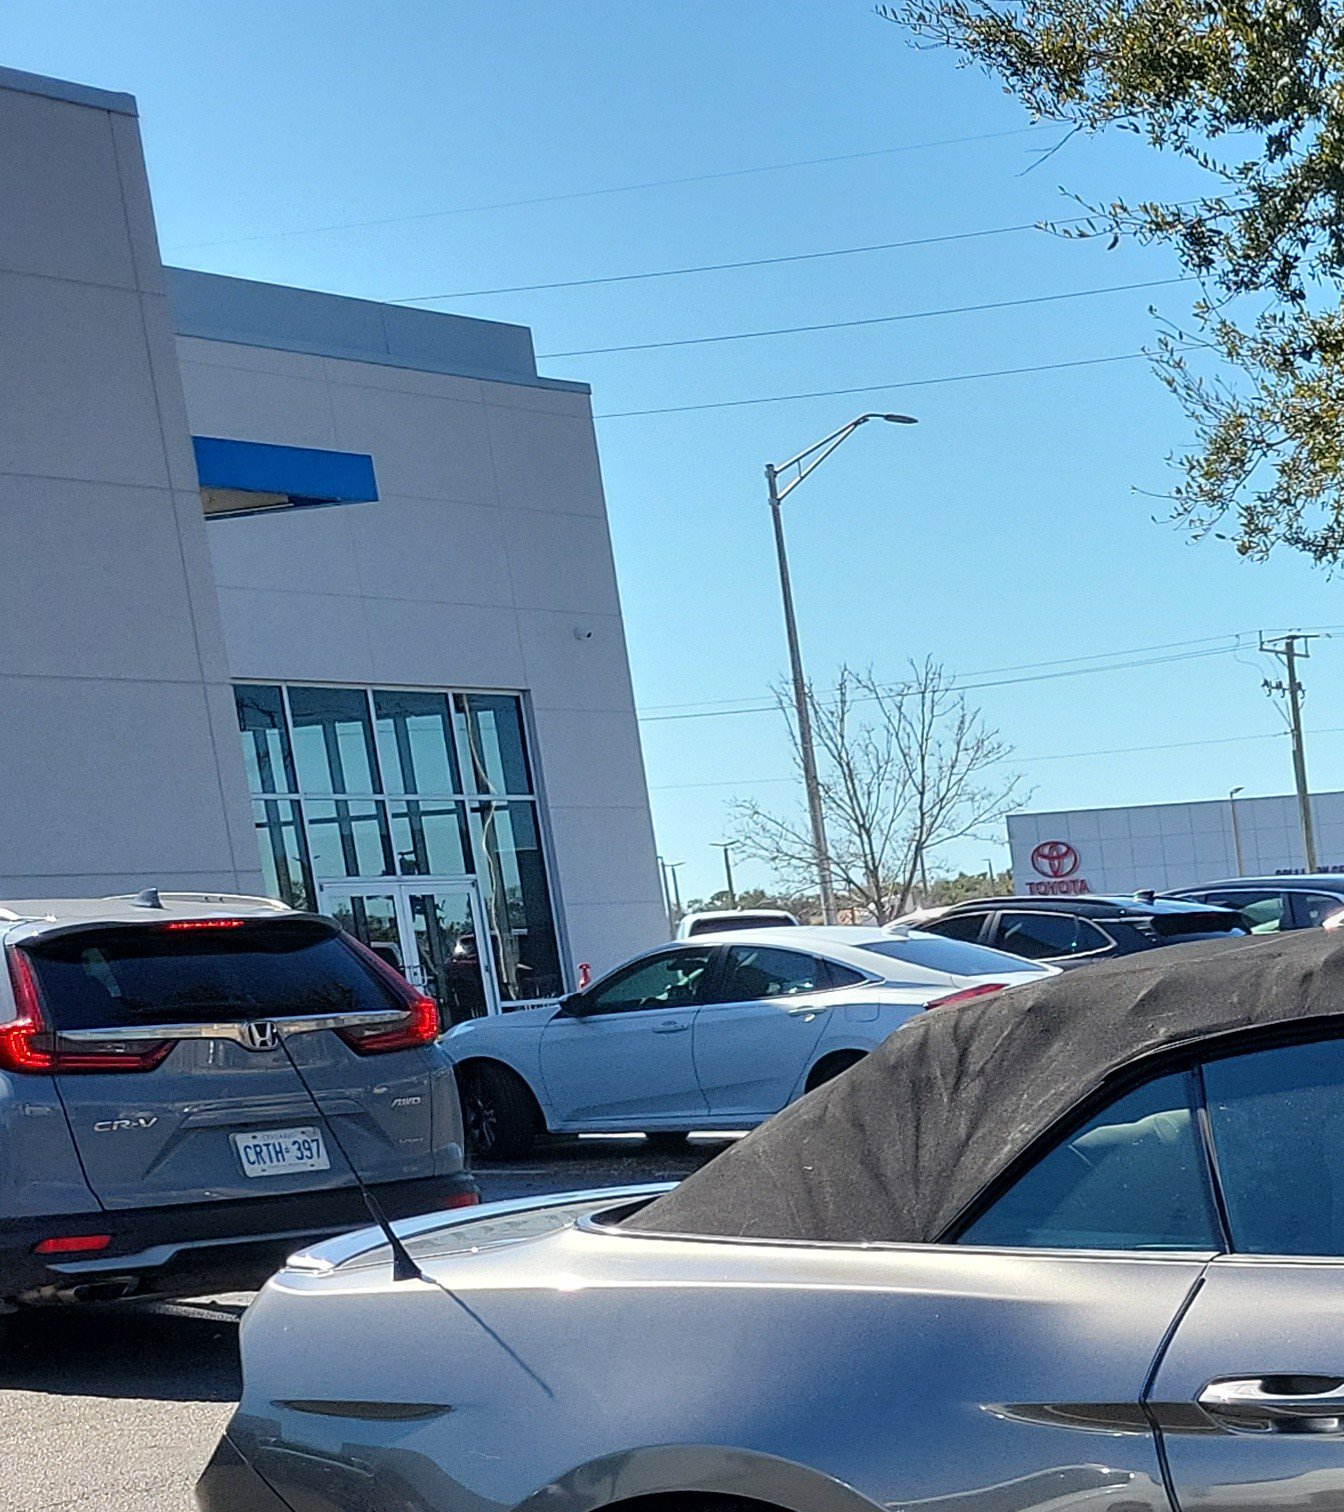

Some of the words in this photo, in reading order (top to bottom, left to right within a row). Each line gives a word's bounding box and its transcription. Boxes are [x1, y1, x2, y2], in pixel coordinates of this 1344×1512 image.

[1025, 879, 1092, 896] TOYOTA
[391, 1096, 421, 1108] AWD
[93, 1117, 158, 1132] CR-V
[243, 1142, 286, 1165] CRTH
[291, 1138, 321, 1161] 397
